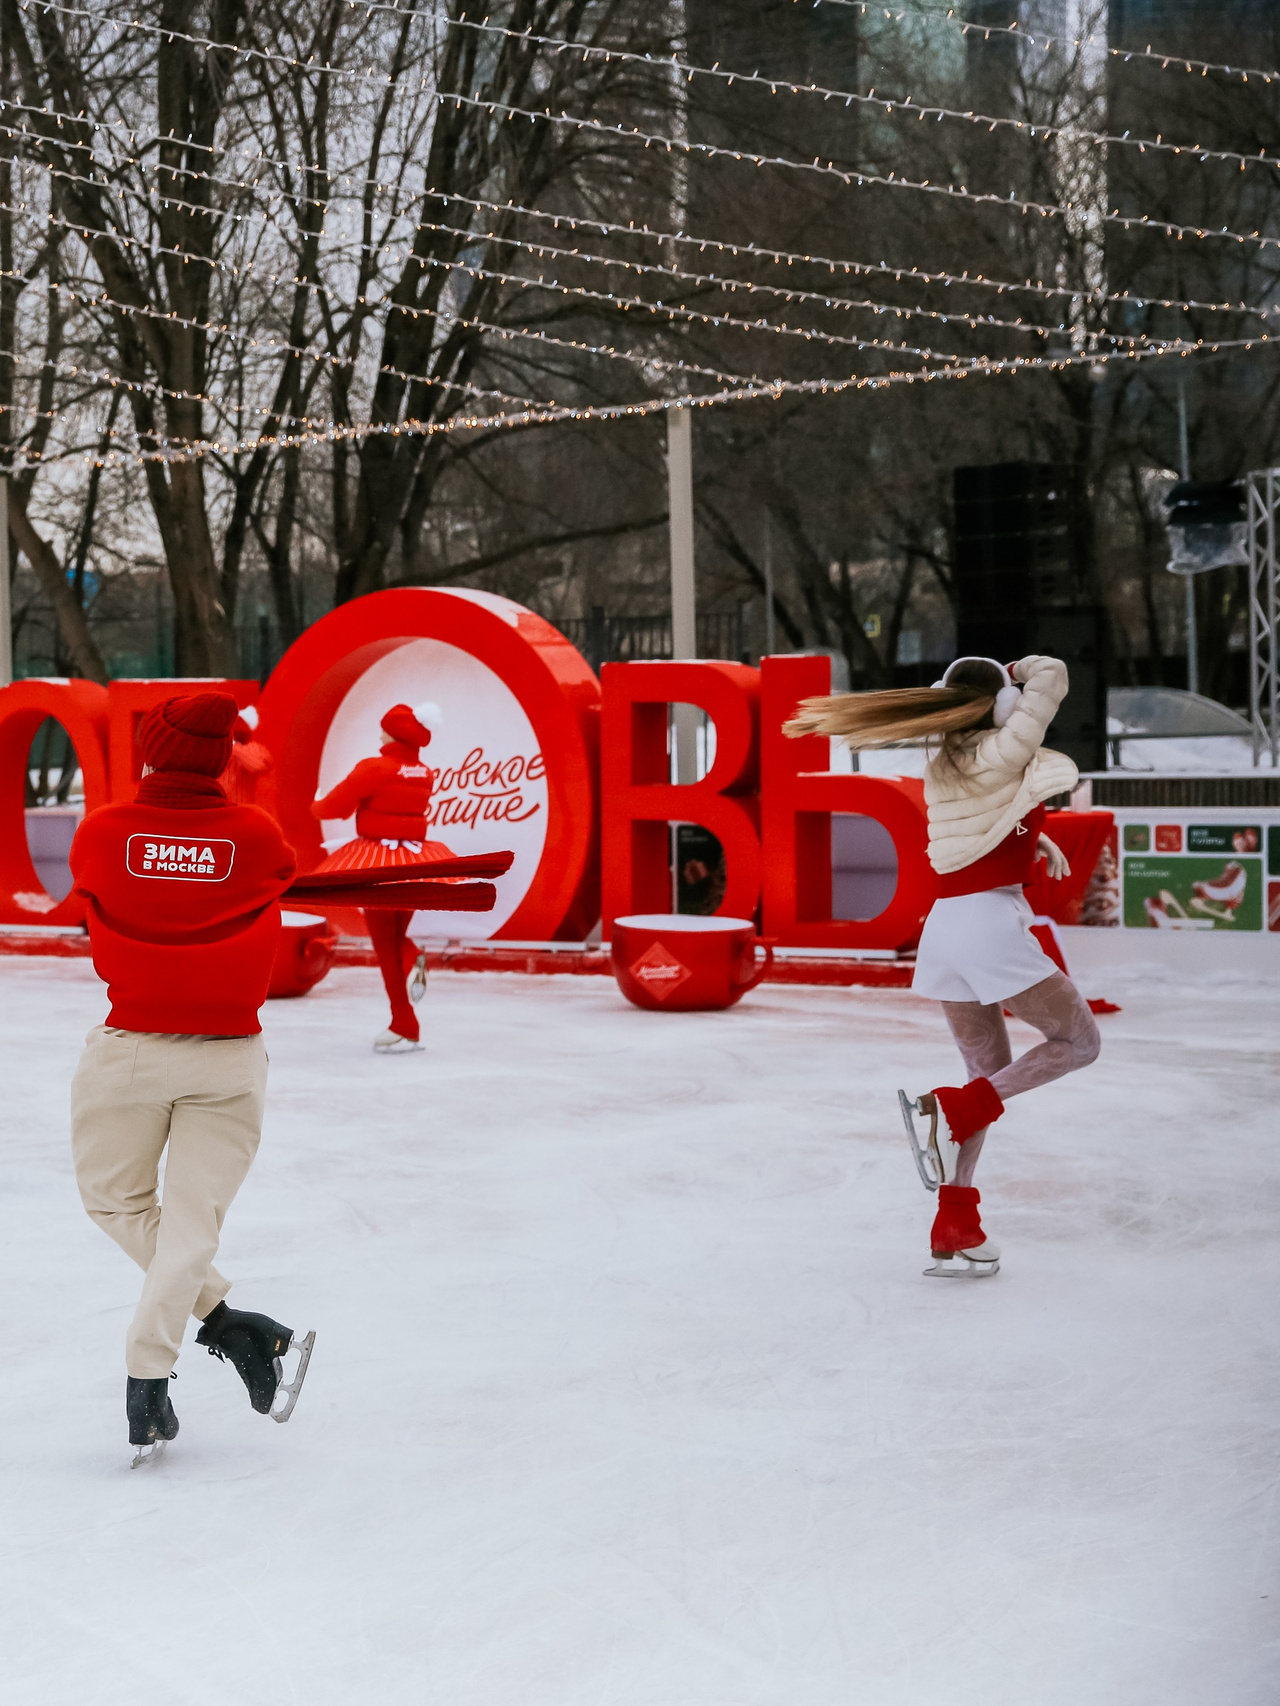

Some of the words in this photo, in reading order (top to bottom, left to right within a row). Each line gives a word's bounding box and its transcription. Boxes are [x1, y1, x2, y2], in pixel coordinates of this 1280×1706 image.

[431, 747, 546, 796] овское
[143, 843, 216, 863] ЗИМА
[142, 860, 153, 870] В
[156, 861, 215, 874] МОСКВЕ
